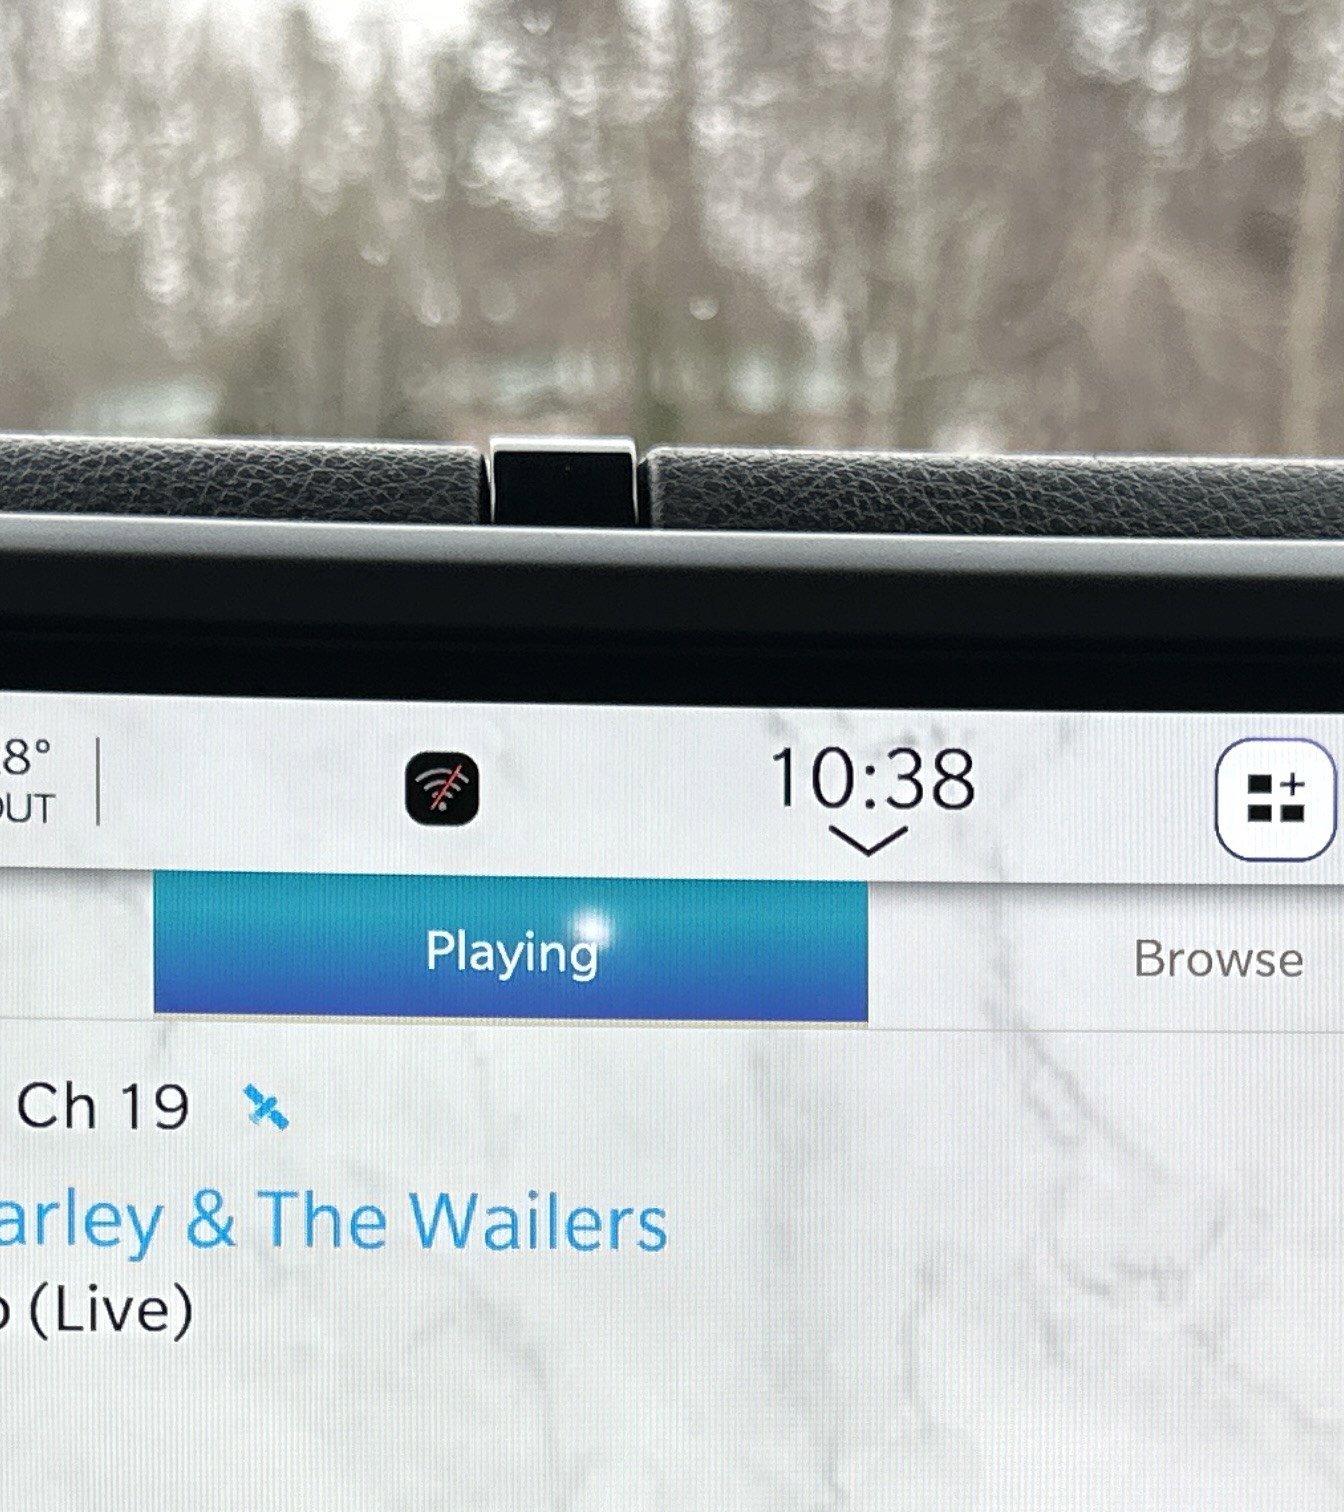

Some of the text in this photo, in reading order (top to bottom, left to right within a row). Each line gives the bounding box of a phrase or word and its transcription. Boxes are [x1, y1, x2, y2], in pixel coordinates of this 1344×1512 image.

[774, 747, 974, 810] 10:38
[426, 928, 599, 983] Playing
[1137, 939, 1303, 977] Browse
[18, 1081, 188, 1129] Ch 19
[188, 1189, 236, 1248] &
[257, 1190, 386, 1249] The
[409, 1190, 666, 1252] Wailers
[31, 1282, 191, 1342] (Live)
